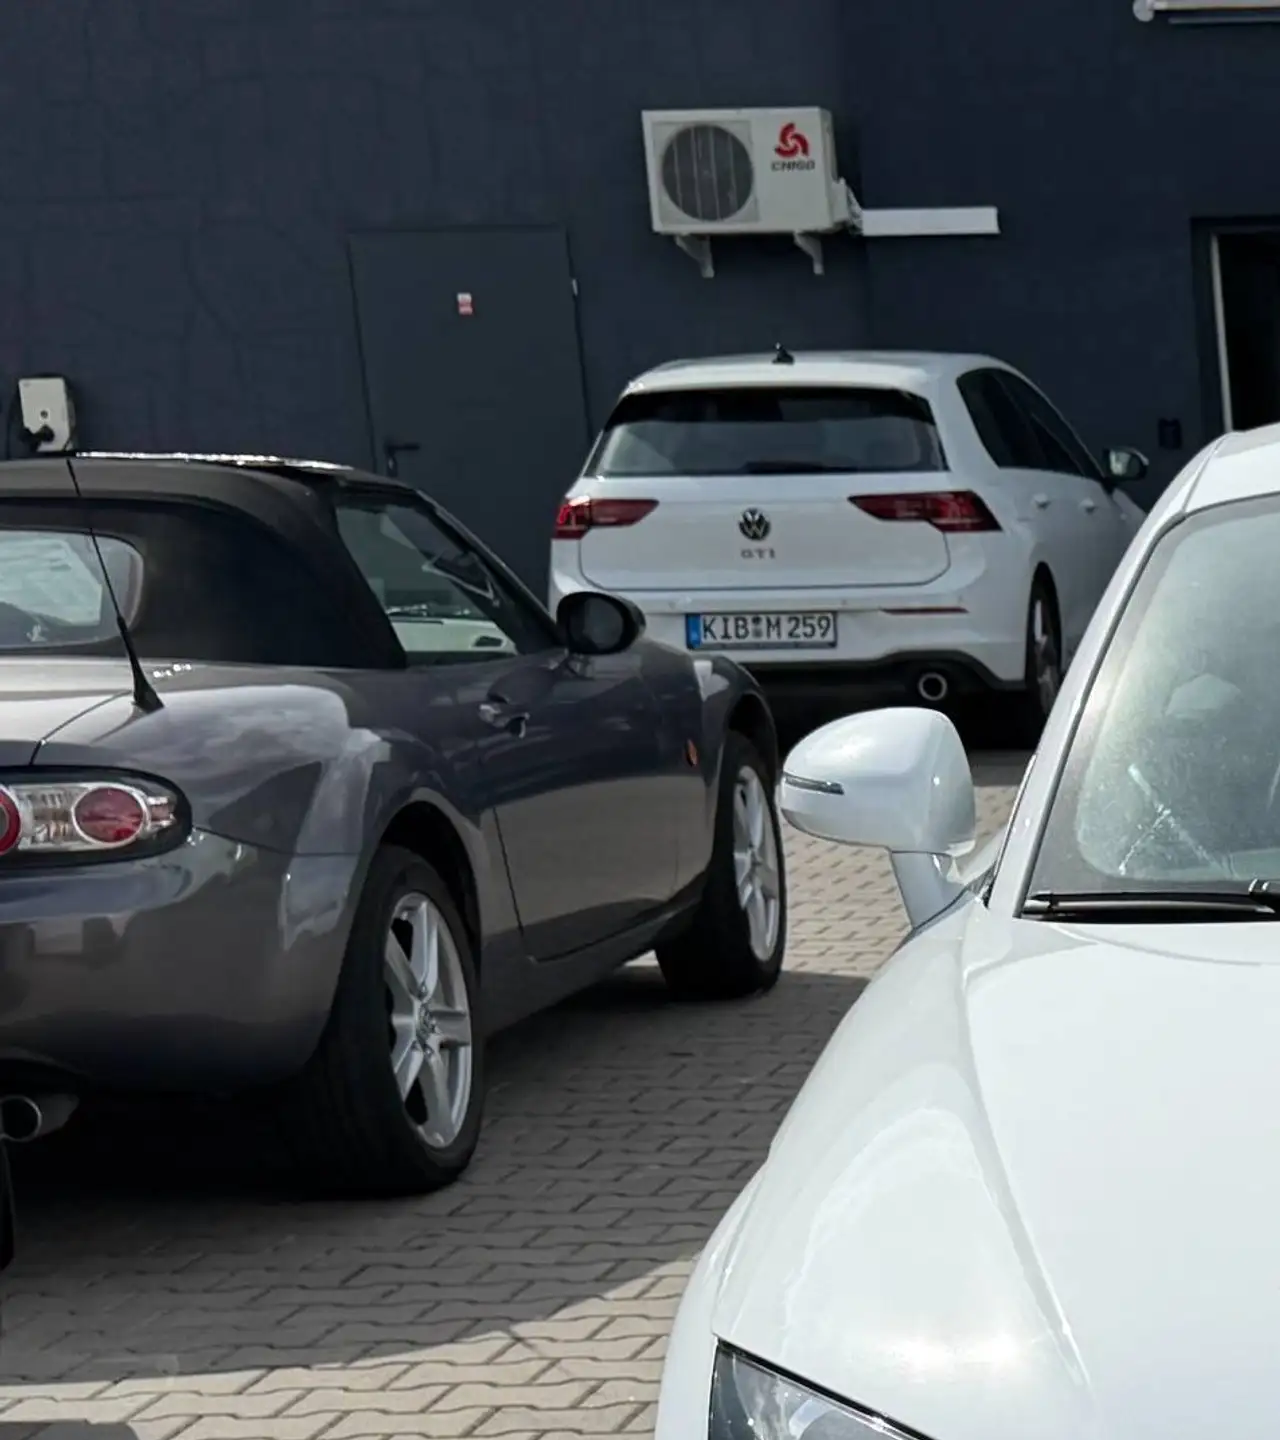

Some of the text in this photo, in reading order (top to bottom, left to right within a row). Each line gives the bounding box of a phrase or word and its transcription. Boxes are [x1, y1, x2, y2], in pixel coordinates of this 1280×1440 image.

[702, 615, 831, 640] KIB M 259
